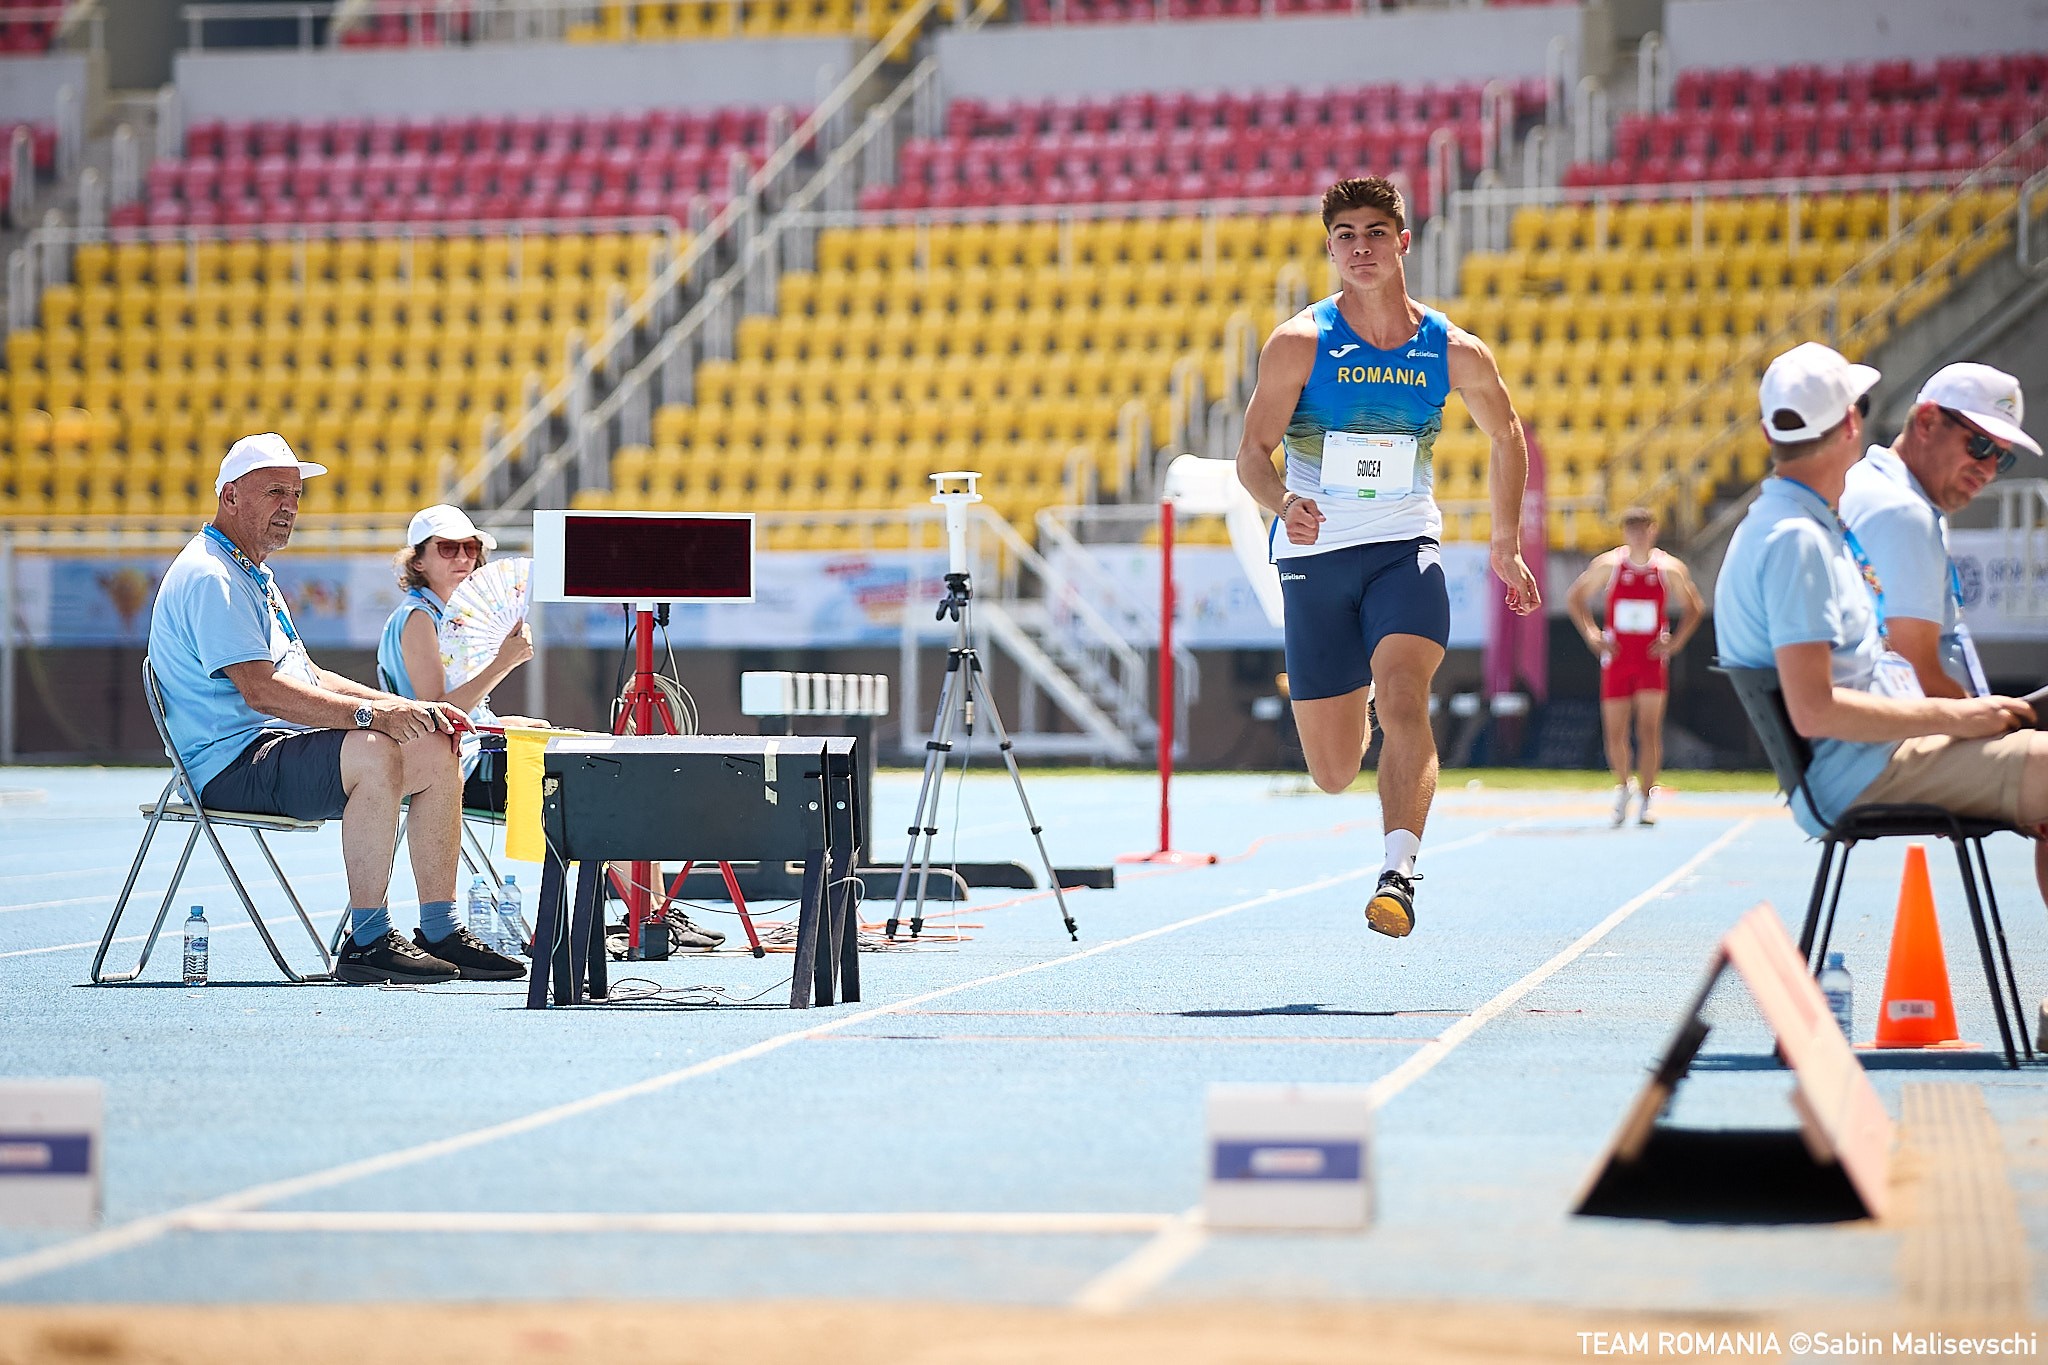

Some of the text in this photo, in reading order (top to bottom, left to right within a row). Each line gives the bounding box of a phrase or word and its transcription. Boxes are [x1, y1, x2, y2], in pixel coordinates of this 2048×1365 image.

[1414, 350, 1439, 359] atletism
[1337, 366, 1427, 387] ROMANIA
[1357, 460, 1381, 477] GOICEA
